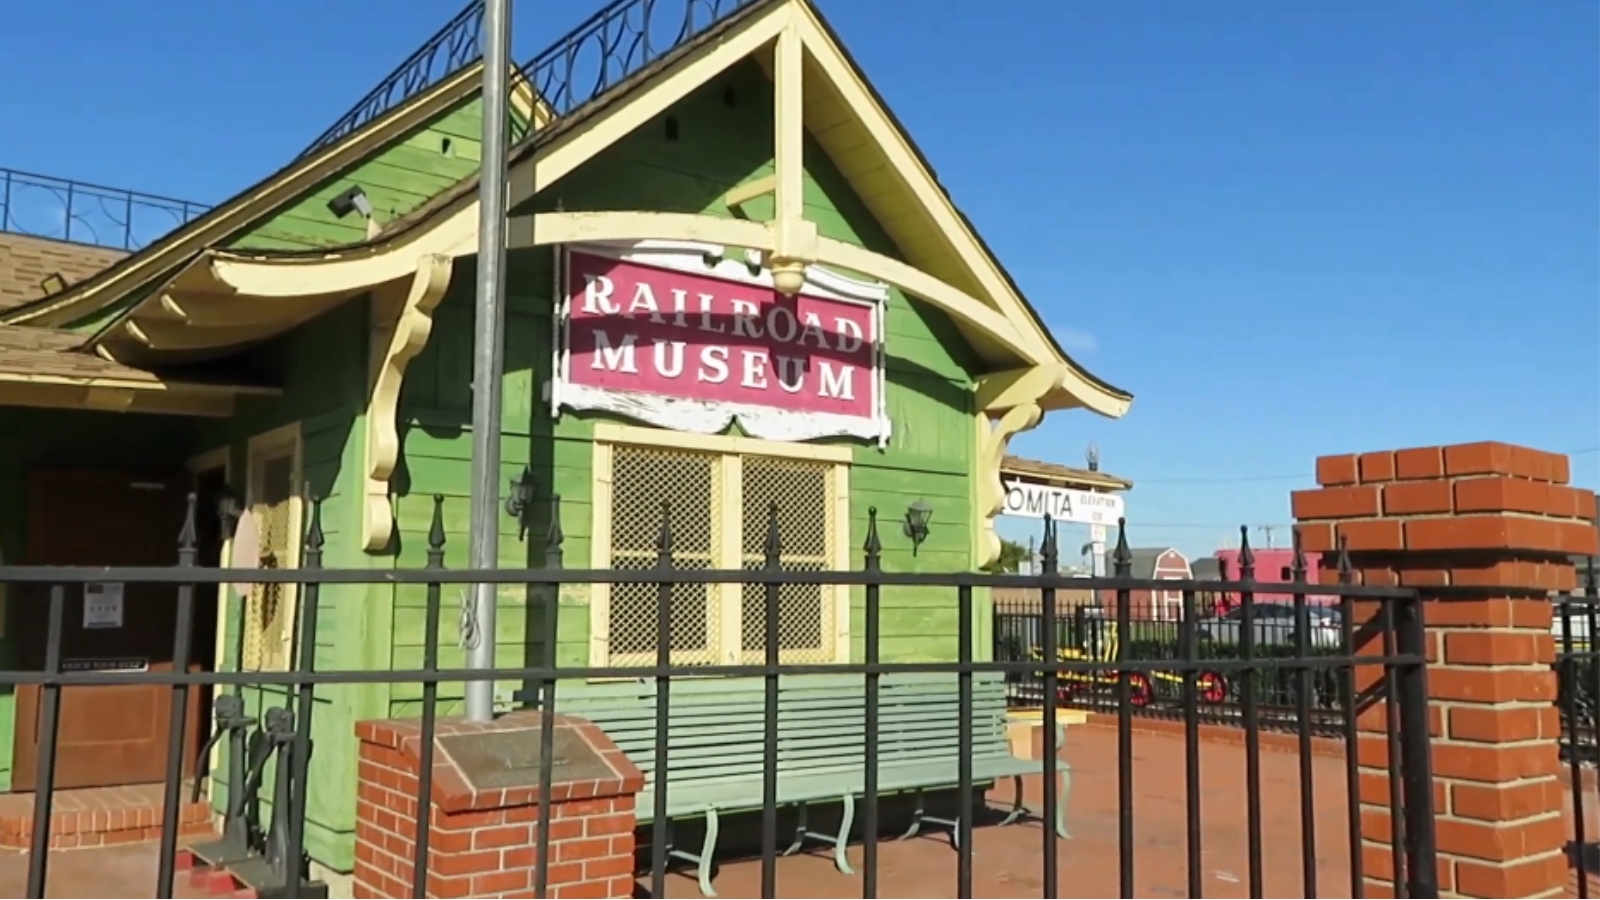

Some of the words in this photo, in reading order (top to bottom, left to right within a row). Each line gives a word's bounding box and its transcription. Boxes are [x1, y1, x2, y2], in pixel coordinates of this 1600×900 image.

[581, 273, 863, 353] RAILROAD
[591, 329, 855, 400] MUSEUM
[1001, 487, 1073, 517] OMITA
